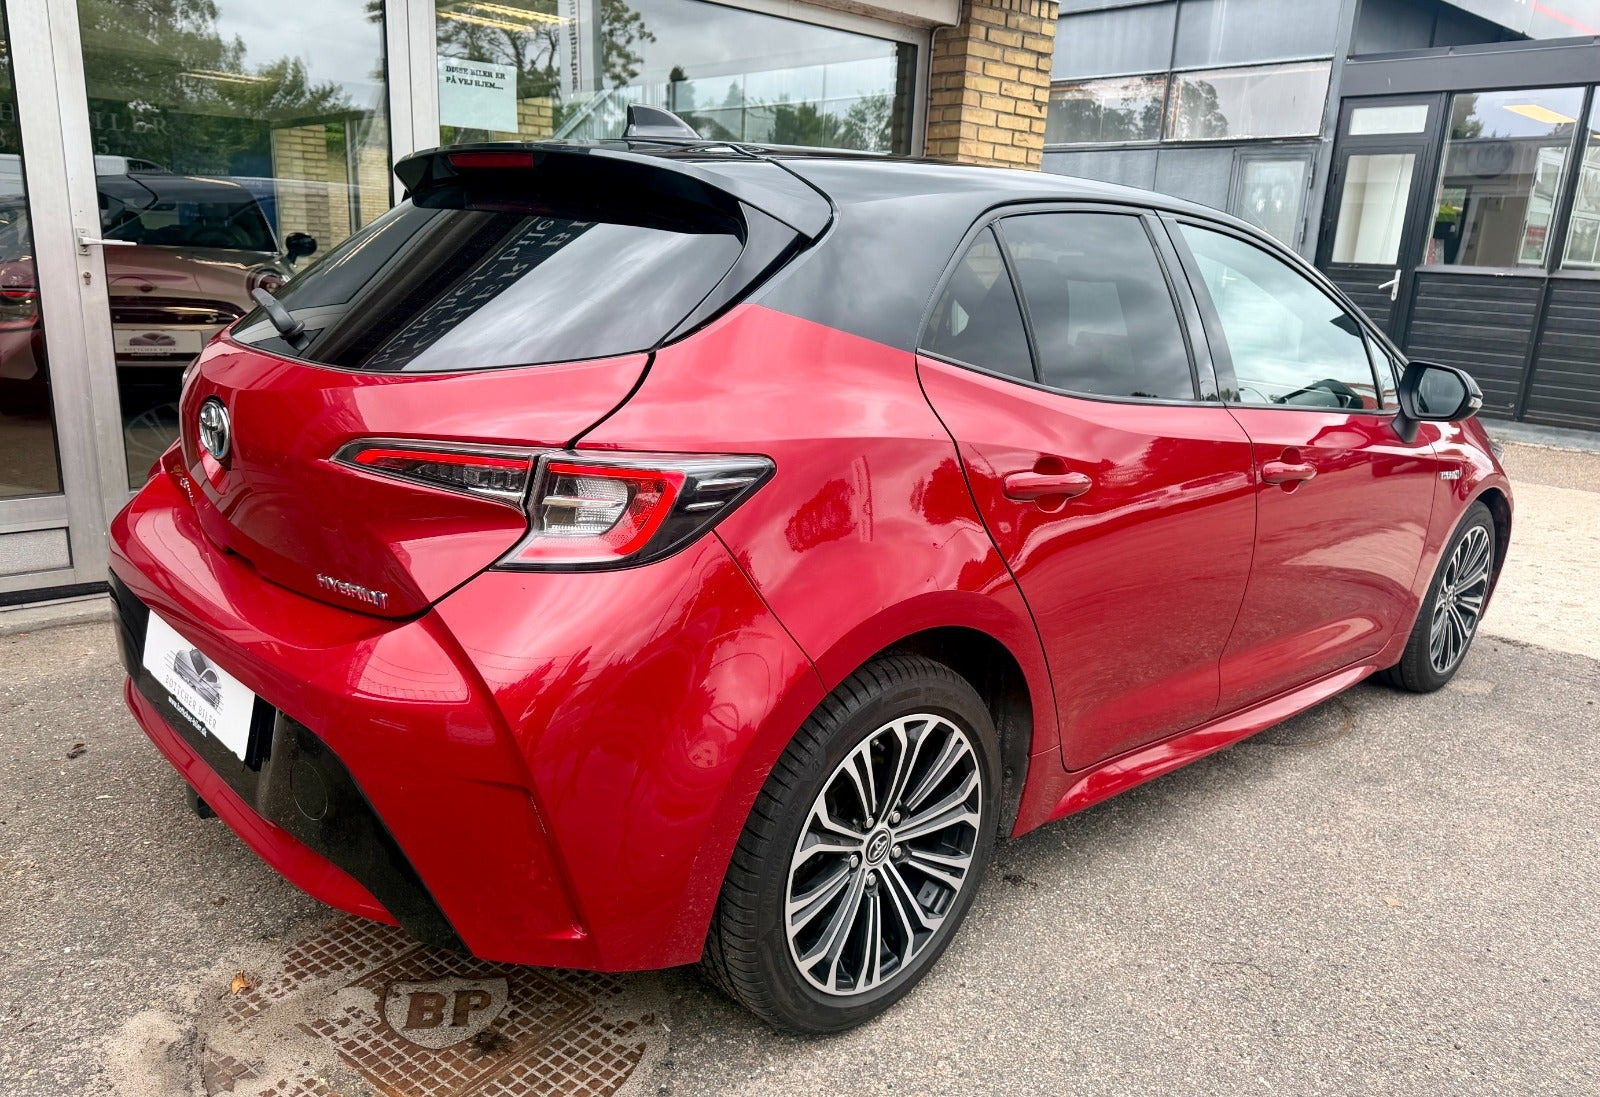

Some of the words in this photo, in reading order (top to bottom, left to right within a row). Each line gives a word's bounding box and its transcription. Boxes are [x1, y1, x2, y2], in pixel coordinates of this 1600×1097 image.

[445, 74, 457, 84] PÅ
[457, 77, 473, 86] VEJ
[470, 68, 493, 79] BILER
[495, 72, 506, 80] ER
[197, 703, 217, 729] BILER
[402, 989, 491, 1029] BP
